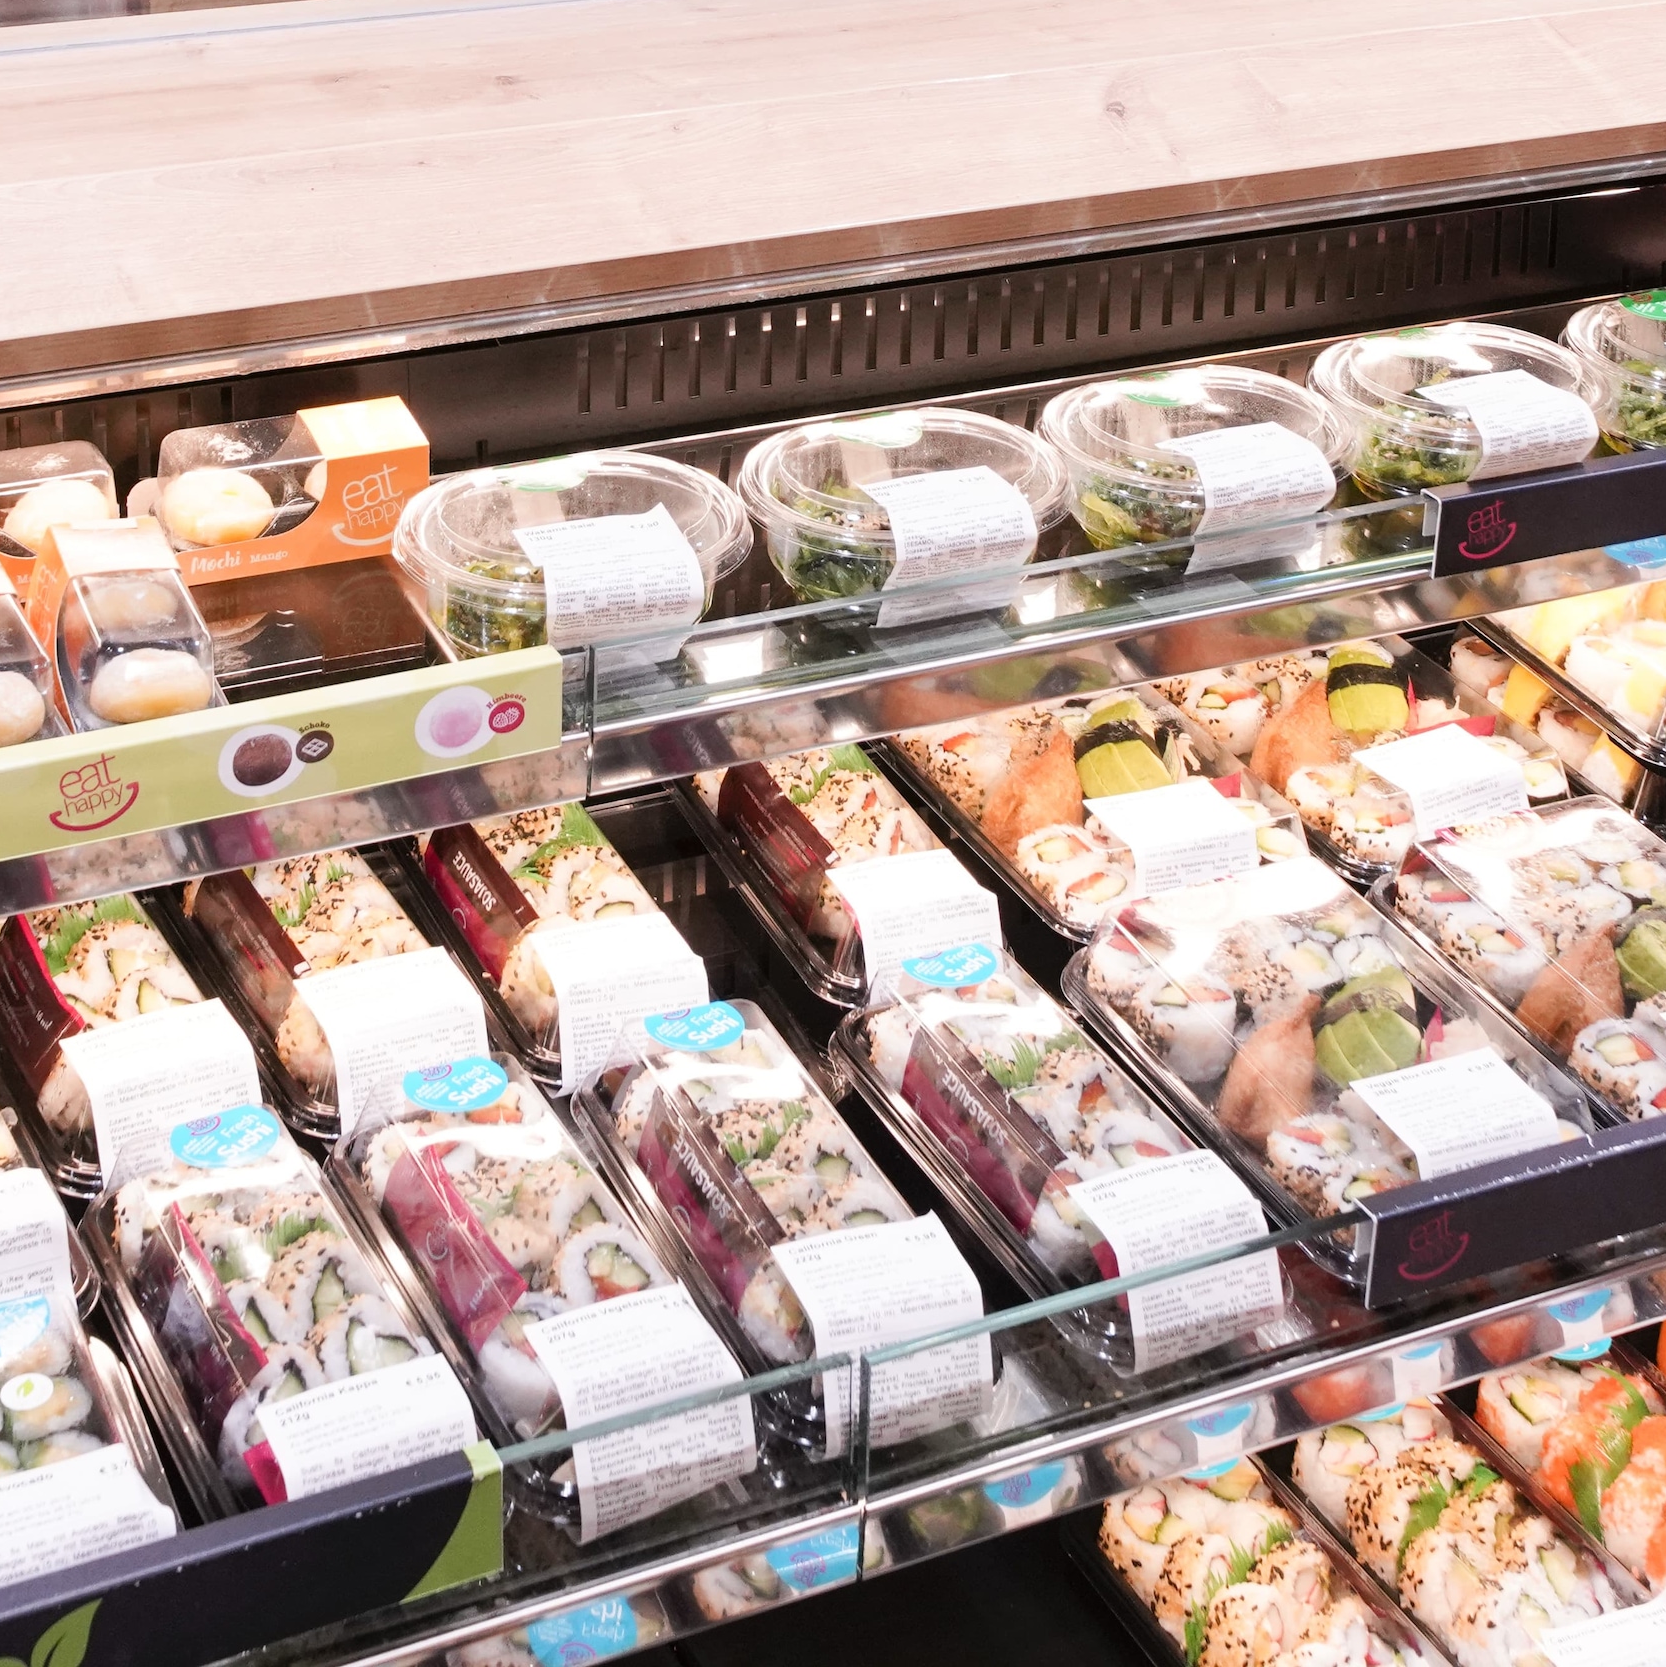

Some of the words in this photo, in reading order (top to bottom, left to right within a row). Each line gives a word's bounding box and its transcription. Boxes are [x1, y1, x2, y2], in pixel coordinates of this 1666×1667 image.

[343, 462, 403, 513] eat
[344, 495, 405, 535] happy
[1467, 500, 1505, 534] eat
[190, 551, 242, 575] Mochi
[250, 549, 289, 565] Mango
[486, 693, 528, 710] Himbeere
[298, 720, 331, 735] Schoko
[59, 753, 122, 800] eat
[63, 782, 124, 820] happy
[452, 850, 498, 912] SOJASAUCE
[944, 952, 992, 981] Sushi
[687, 1013, 741, 1045] Sushi
[448, 1070, 504, 1106] Sushi
[942, 1070, 1007, 1147] SOJASAUCE
[673, 1129, 732, 1220] SOJASAUCE
[1409, 1211, 1451, 1252] eat
